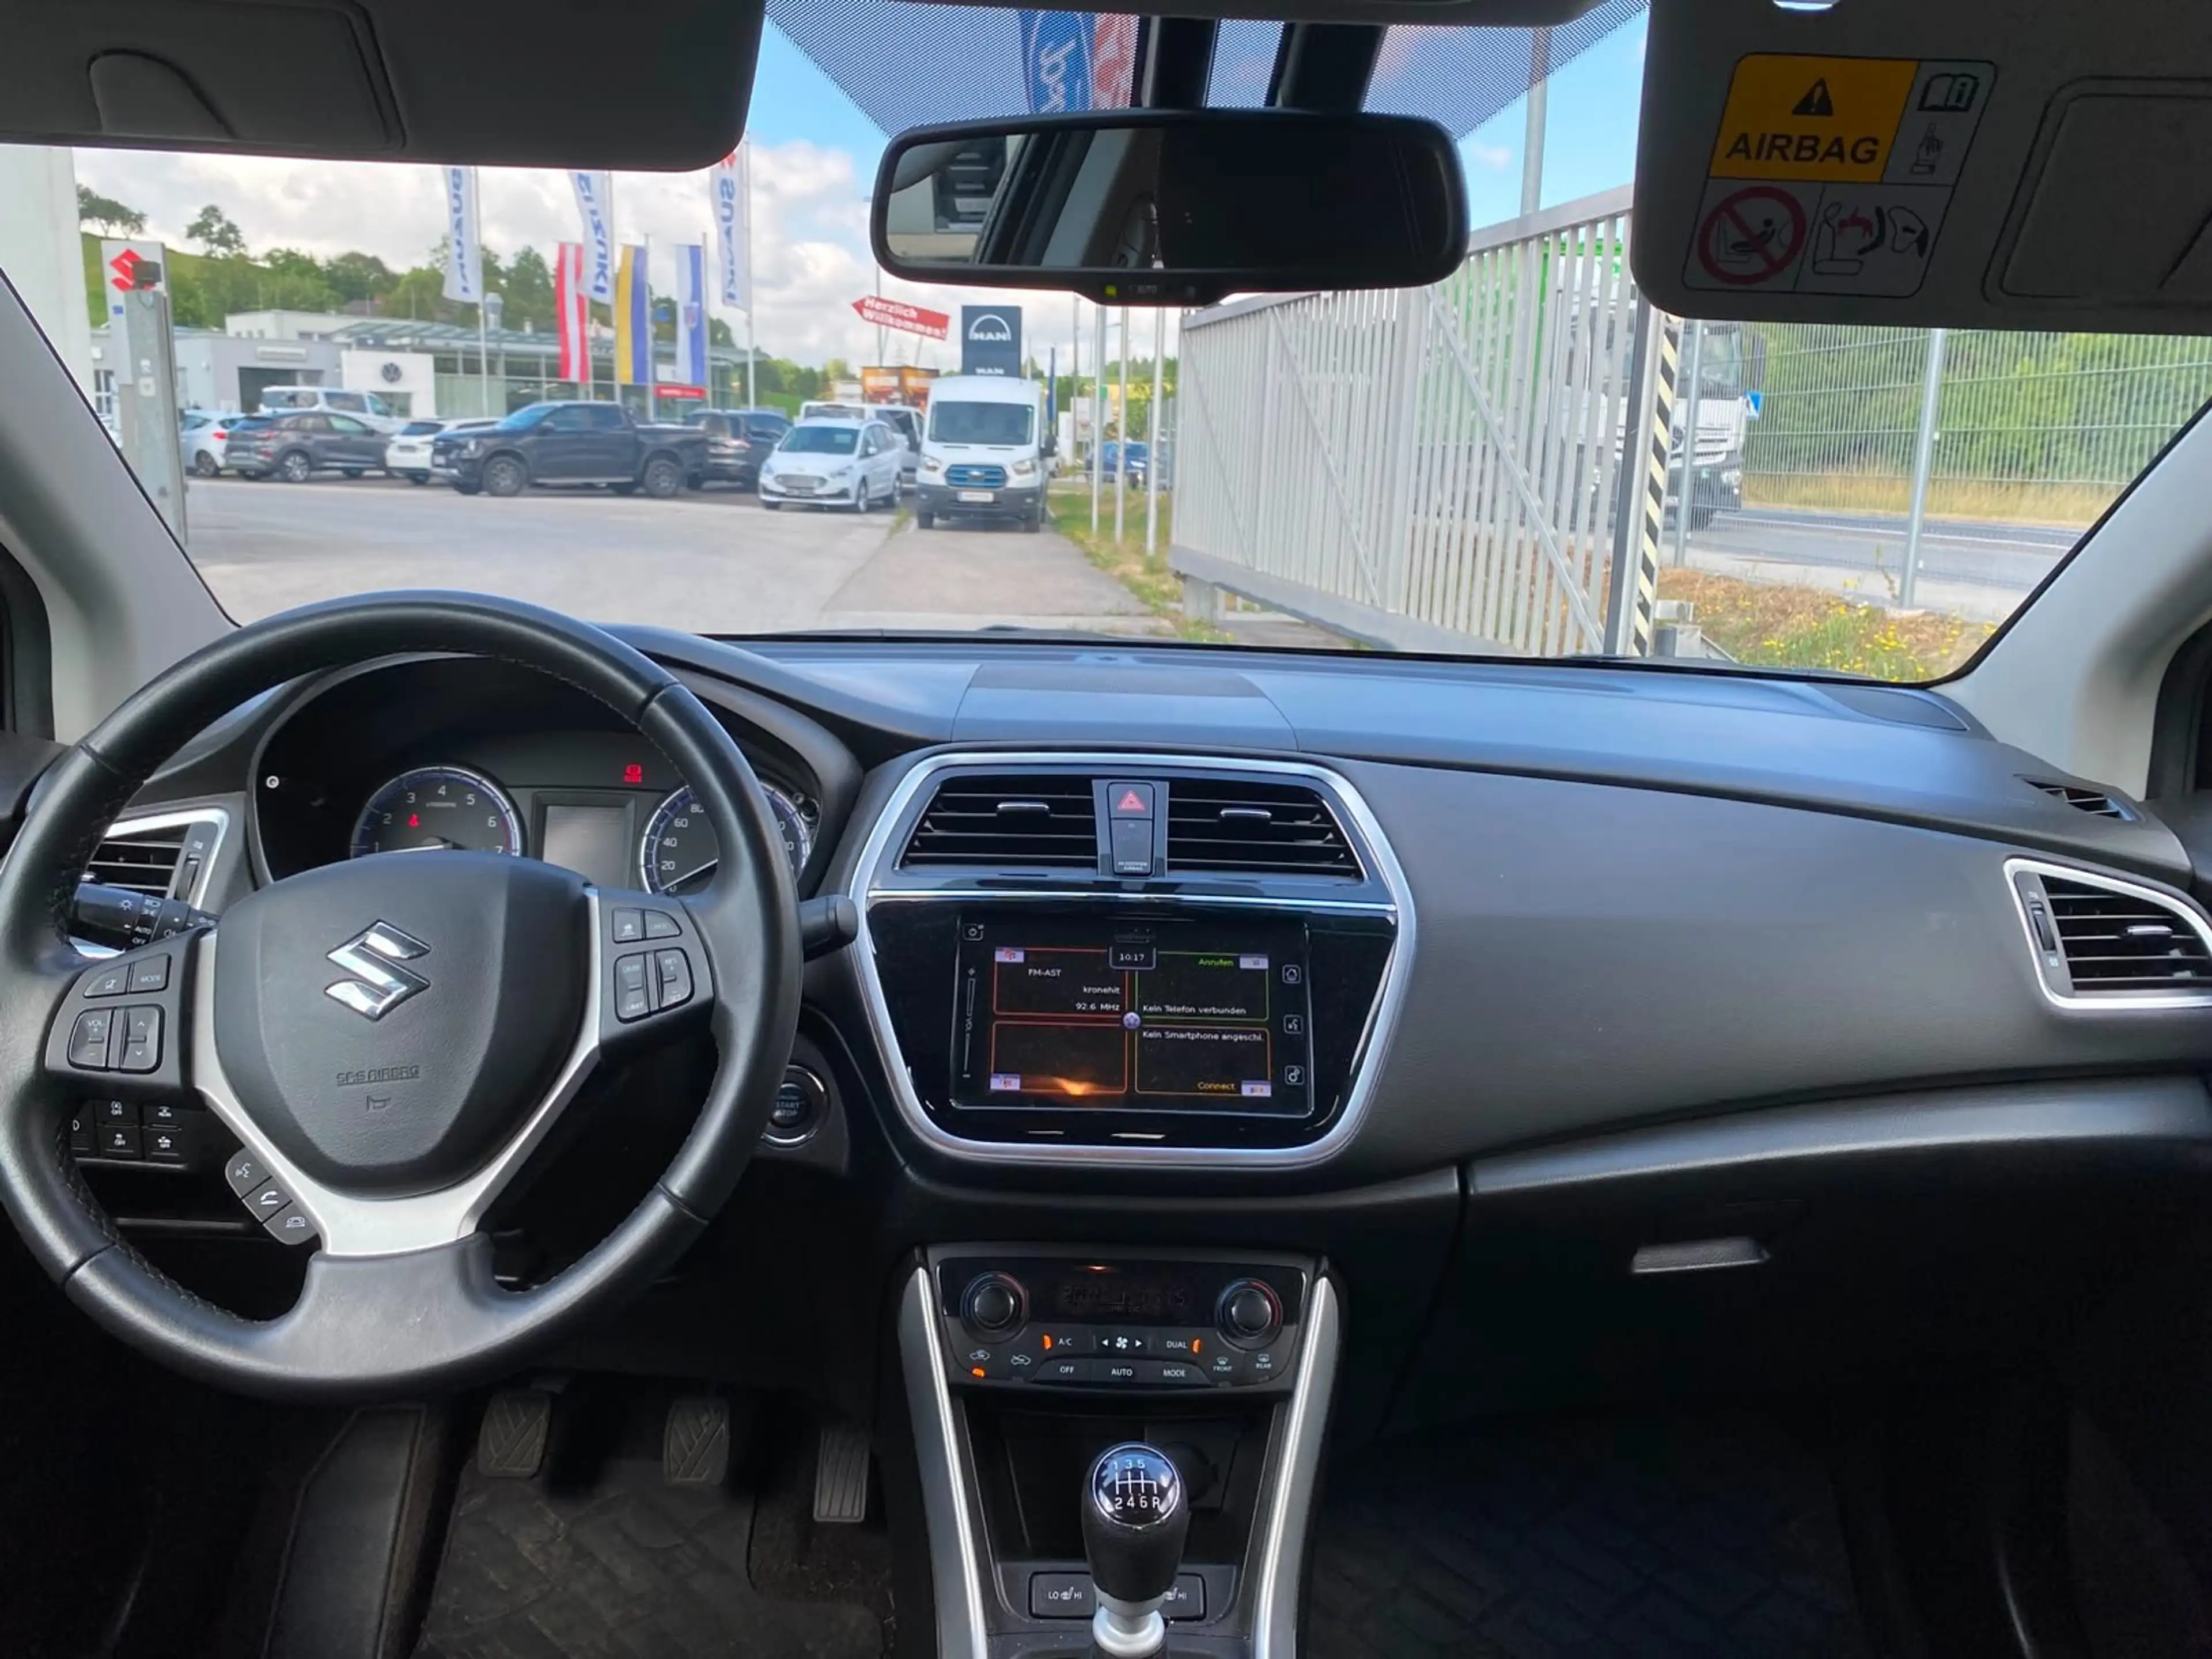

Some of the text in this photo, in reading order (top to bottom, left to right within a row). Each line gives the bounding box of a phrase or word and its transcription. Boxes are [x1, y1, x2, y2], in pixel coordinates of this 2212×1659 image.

[1725, 132, 1880, 165] AIRBAG
[864, 296, 918, 319] Herzlich
[973, 332, 1007, 340] MAN
[438, 785, 446, 796] 4
[408, 793, 415, 804] 3
[467, 794, 475, 805] 5
[383, 813, 392, 824] 2
[488, 816, 497, 828] 6
[674, 818, 688, 828] 60
[663, 838, 677, 847] 40
[661, 861, 676, 870] 20
[1119, 953, 1145, 961] 10:17
[1198, 959, 1234, 968] Anrufen
[1028, 968, 1062, 977] FM-AST
[1082, 986, 1120, 995] kronehit
[1075, 1002, 1120, 1012] 92.6 MHz
[1143, 1004, 1247, 1016] Kein Telefon verbunden
[1143, 1030, 1162, 1039] Kein
[1165, 1031, 1219, 1041] Smartphone
[1196, 1081, 1236, 1090] Connect
[1058, 1338, 1073, 1347] A/C
[1166, 1340, 1188, 1349] DUAL
[1059, 1365, 1074, 1374] OFF
[1111, 1367, 1134, 1377] AUTO
[1162, 1368, 1185, 1378] MODE
[1125, 1459, 1133, 1469] 3
[1137, 1459, 1146, 1468] 5
[1114, 1496, 1161, 1510] 2 4 6 R
[1047, 1590, 1083, 1600] LO HI
[1178, 1592, 1187, 1600] HI
